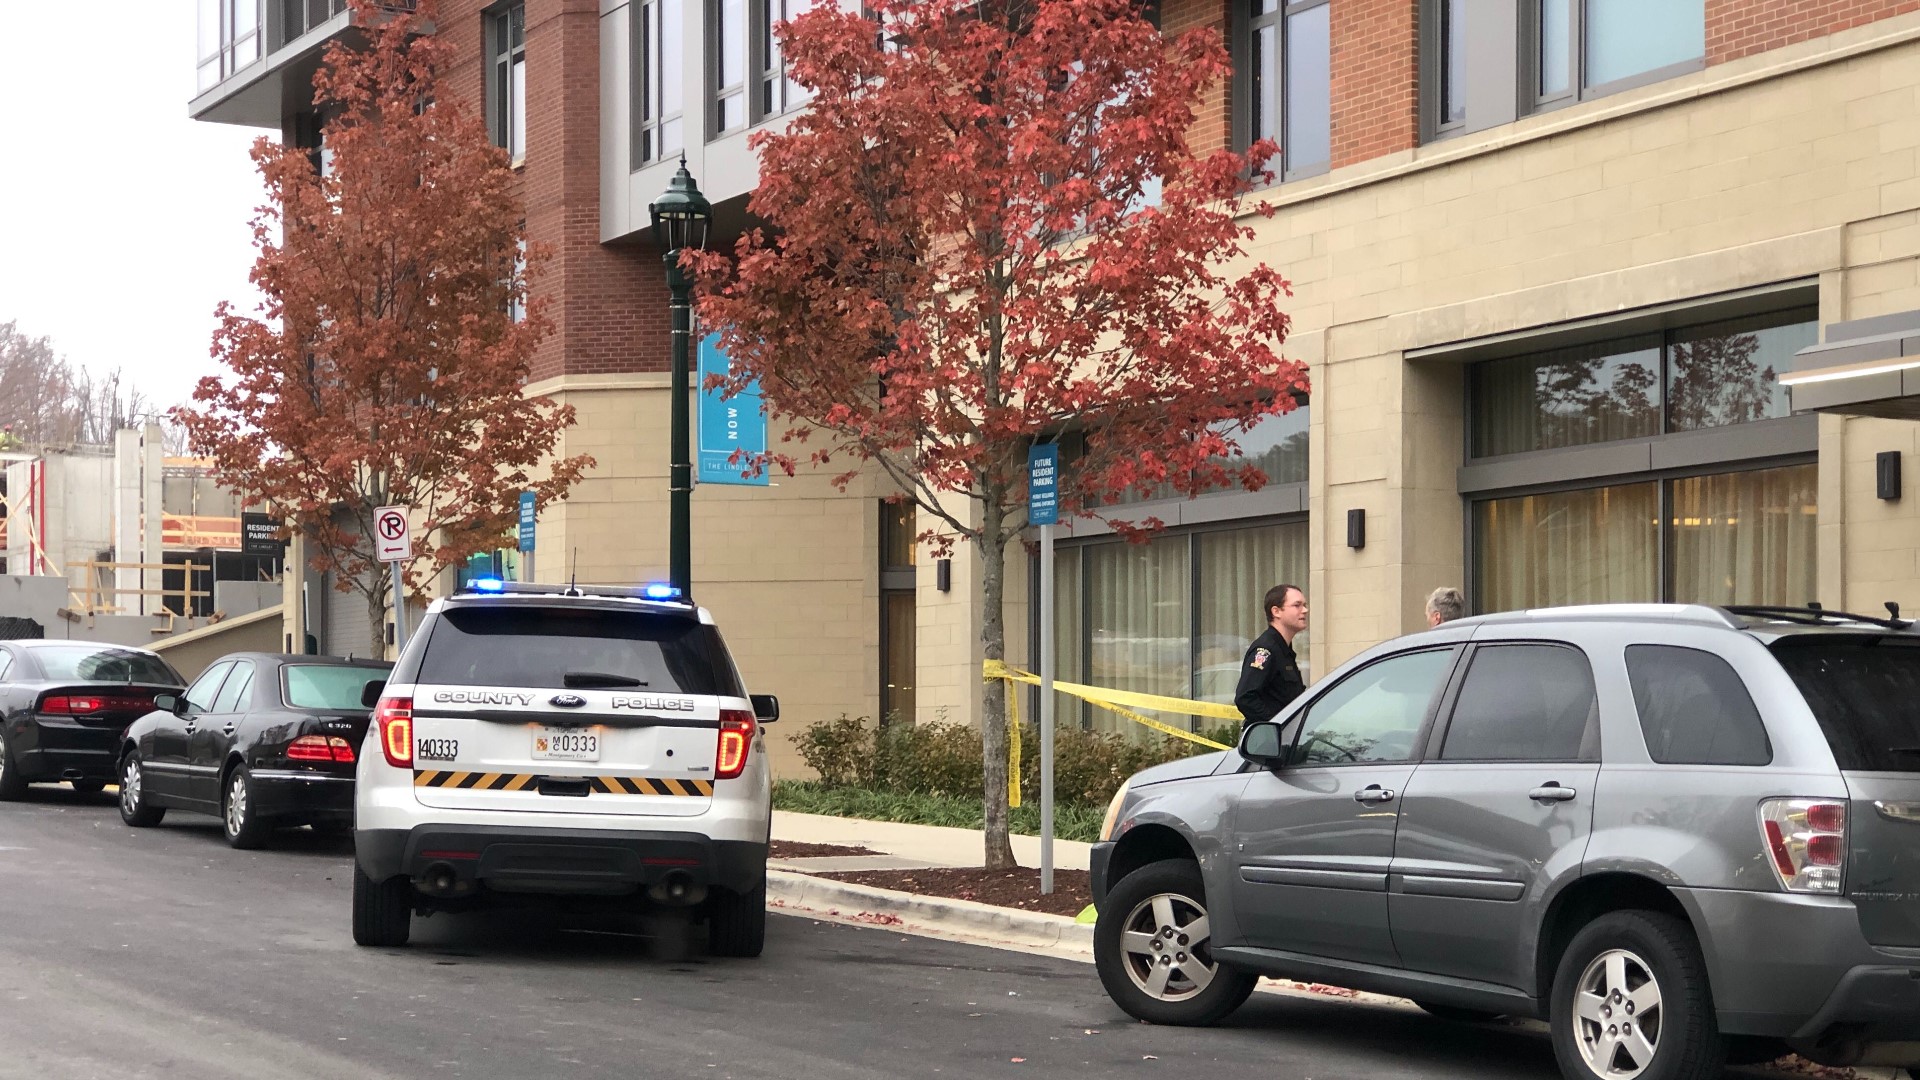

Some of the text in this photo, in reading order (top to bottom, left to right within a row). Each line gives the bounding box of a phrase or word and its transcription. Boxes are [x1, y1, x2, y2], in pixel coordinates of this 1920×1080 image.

[728, 408, 738, 440] NOW
[708, 462, 751, 471] THE LINDLE
[1034, 458, 1052, 467] FUTURE
[1032, 467, 1054, 477] RESIDENT
[1034, 477, 1053, 486] PARKING
[247, 524, 280, 532] RESIDENT
[248, 532, 279, 540] PARKI
[434, 690, 536, 706] COUNTY
[556, 695, 578, 705] Ford
[612, 696, 694, 712] POLICE
[417, 738, 459, 758] 140333
[562, 735, 597, 752] 0333
